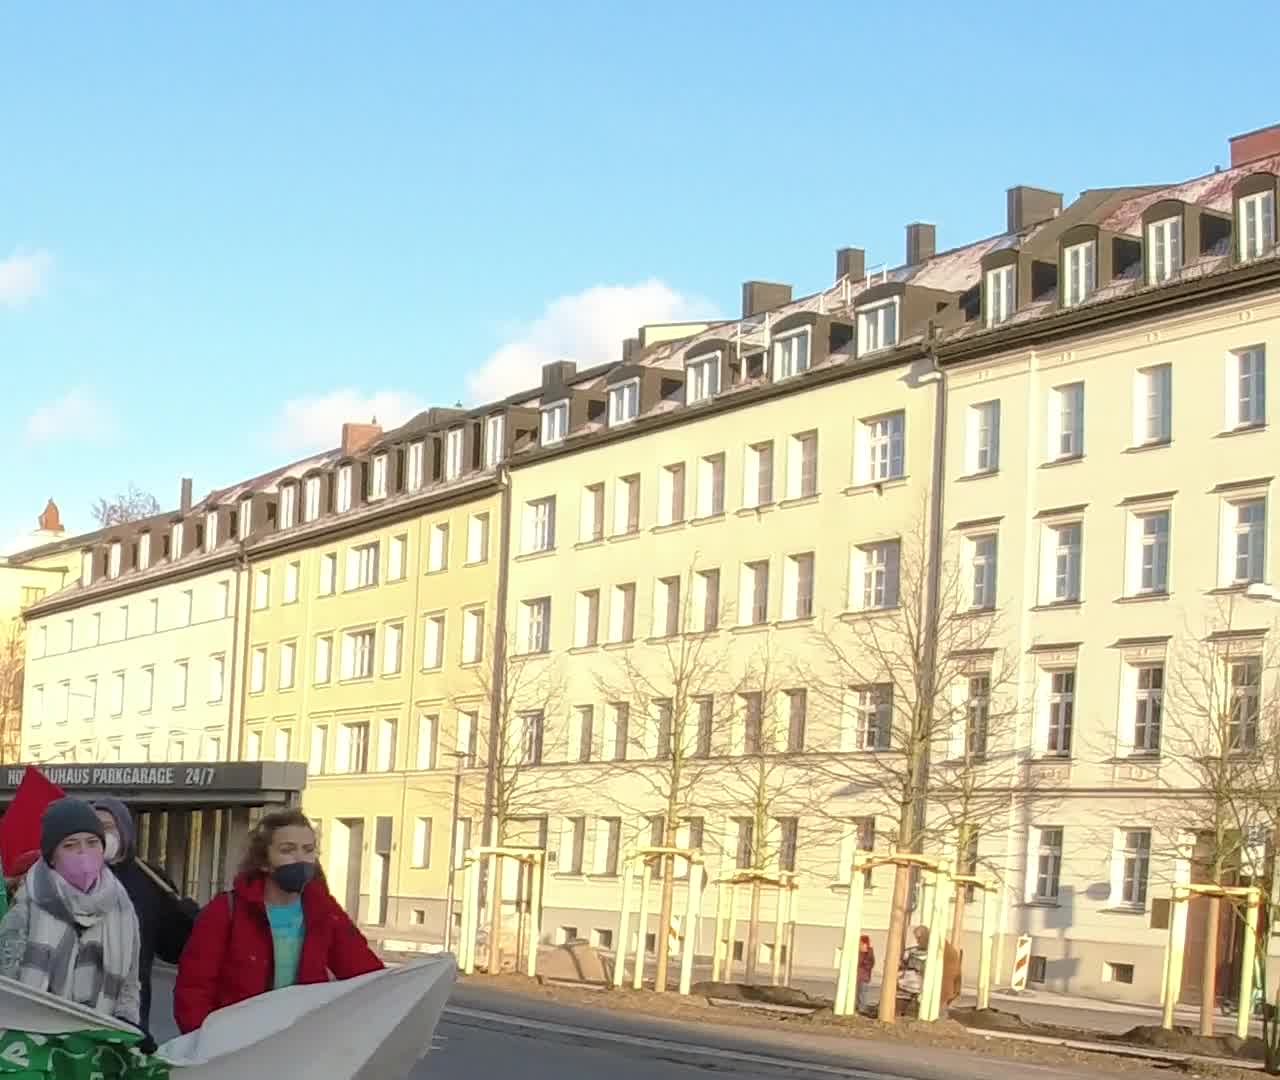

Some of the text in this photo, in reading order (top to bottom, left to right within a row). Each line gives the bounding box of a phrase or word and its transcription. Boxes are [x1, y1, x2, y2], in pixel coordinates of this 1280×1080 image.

[41, 767, 90, 785] AUHAUS
[92, 767, 174, 785] PARKGARAGE
[184, 767, 215, 786] 24/7
